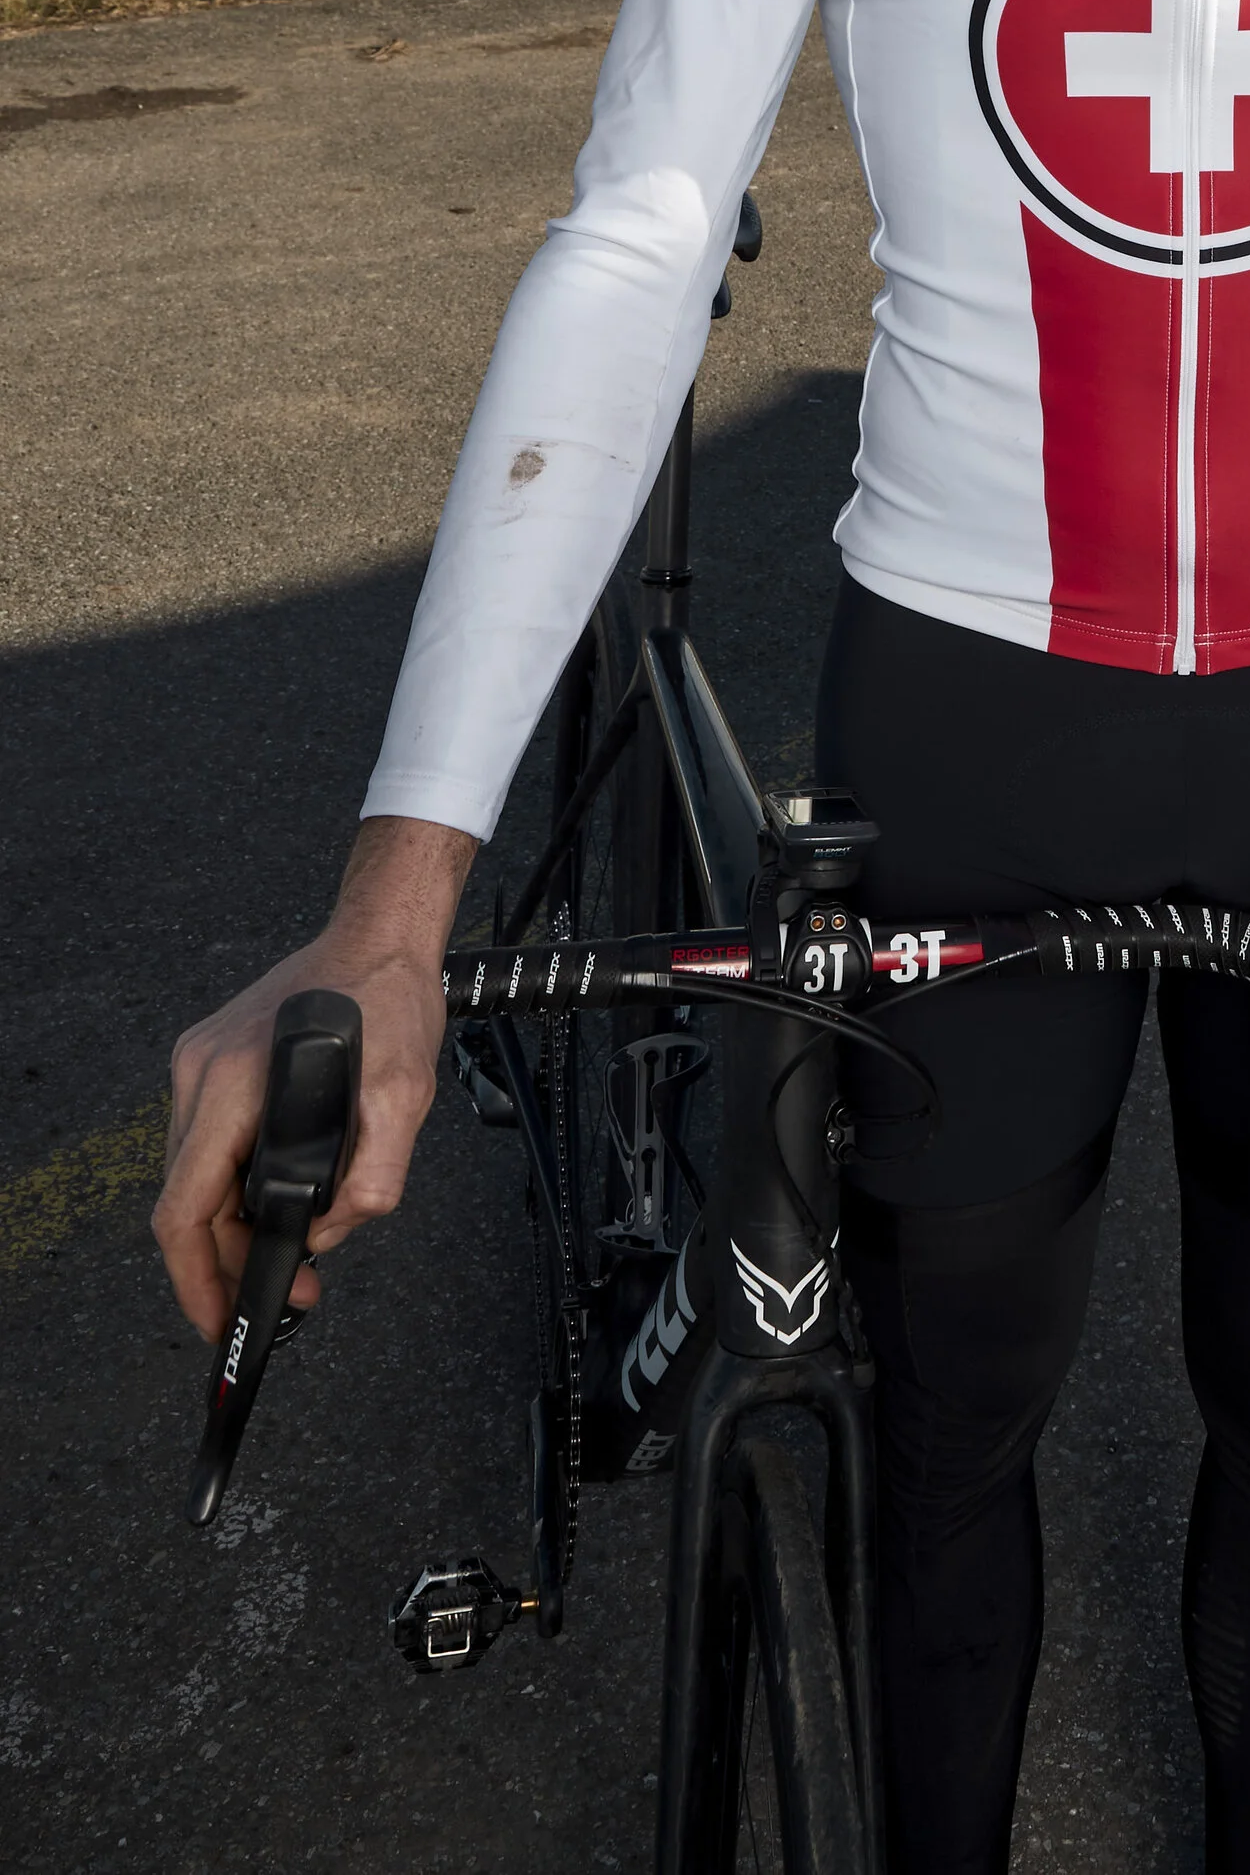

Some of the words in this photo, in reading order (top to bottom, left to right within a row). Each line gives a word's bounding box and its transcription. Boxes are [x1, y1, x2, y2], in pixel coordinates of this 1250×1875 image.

[670, 945, 749, 962] RGOTER
[804, 943, 848, 993] 3T
[890, 930, 947, 984] 3T
[1121, 948, 1130, 970] trem
[625, 1428, 678, 1471] FELT
